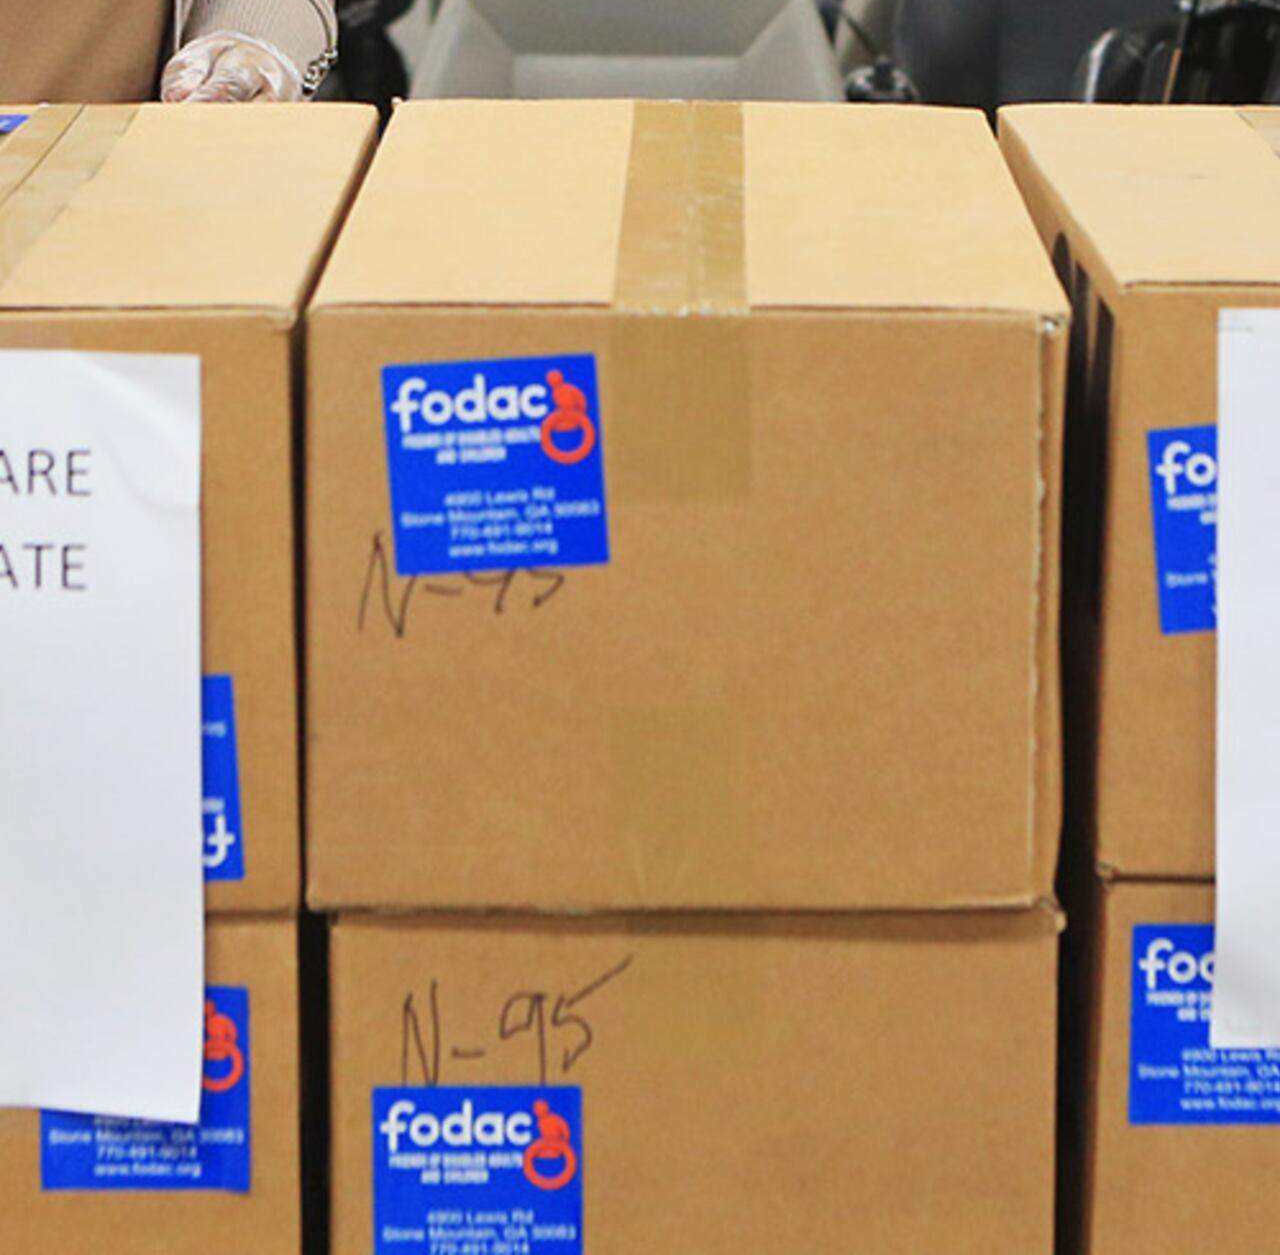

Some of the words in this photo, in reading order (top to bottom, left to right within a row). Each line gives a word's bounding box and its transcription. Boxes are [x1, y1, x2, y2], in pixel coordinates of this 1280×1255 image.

[390, 373, 548, 433] fodac
[401, 954, 633, 1086] N-95
[380, 1098, 533, 1153] fodac
